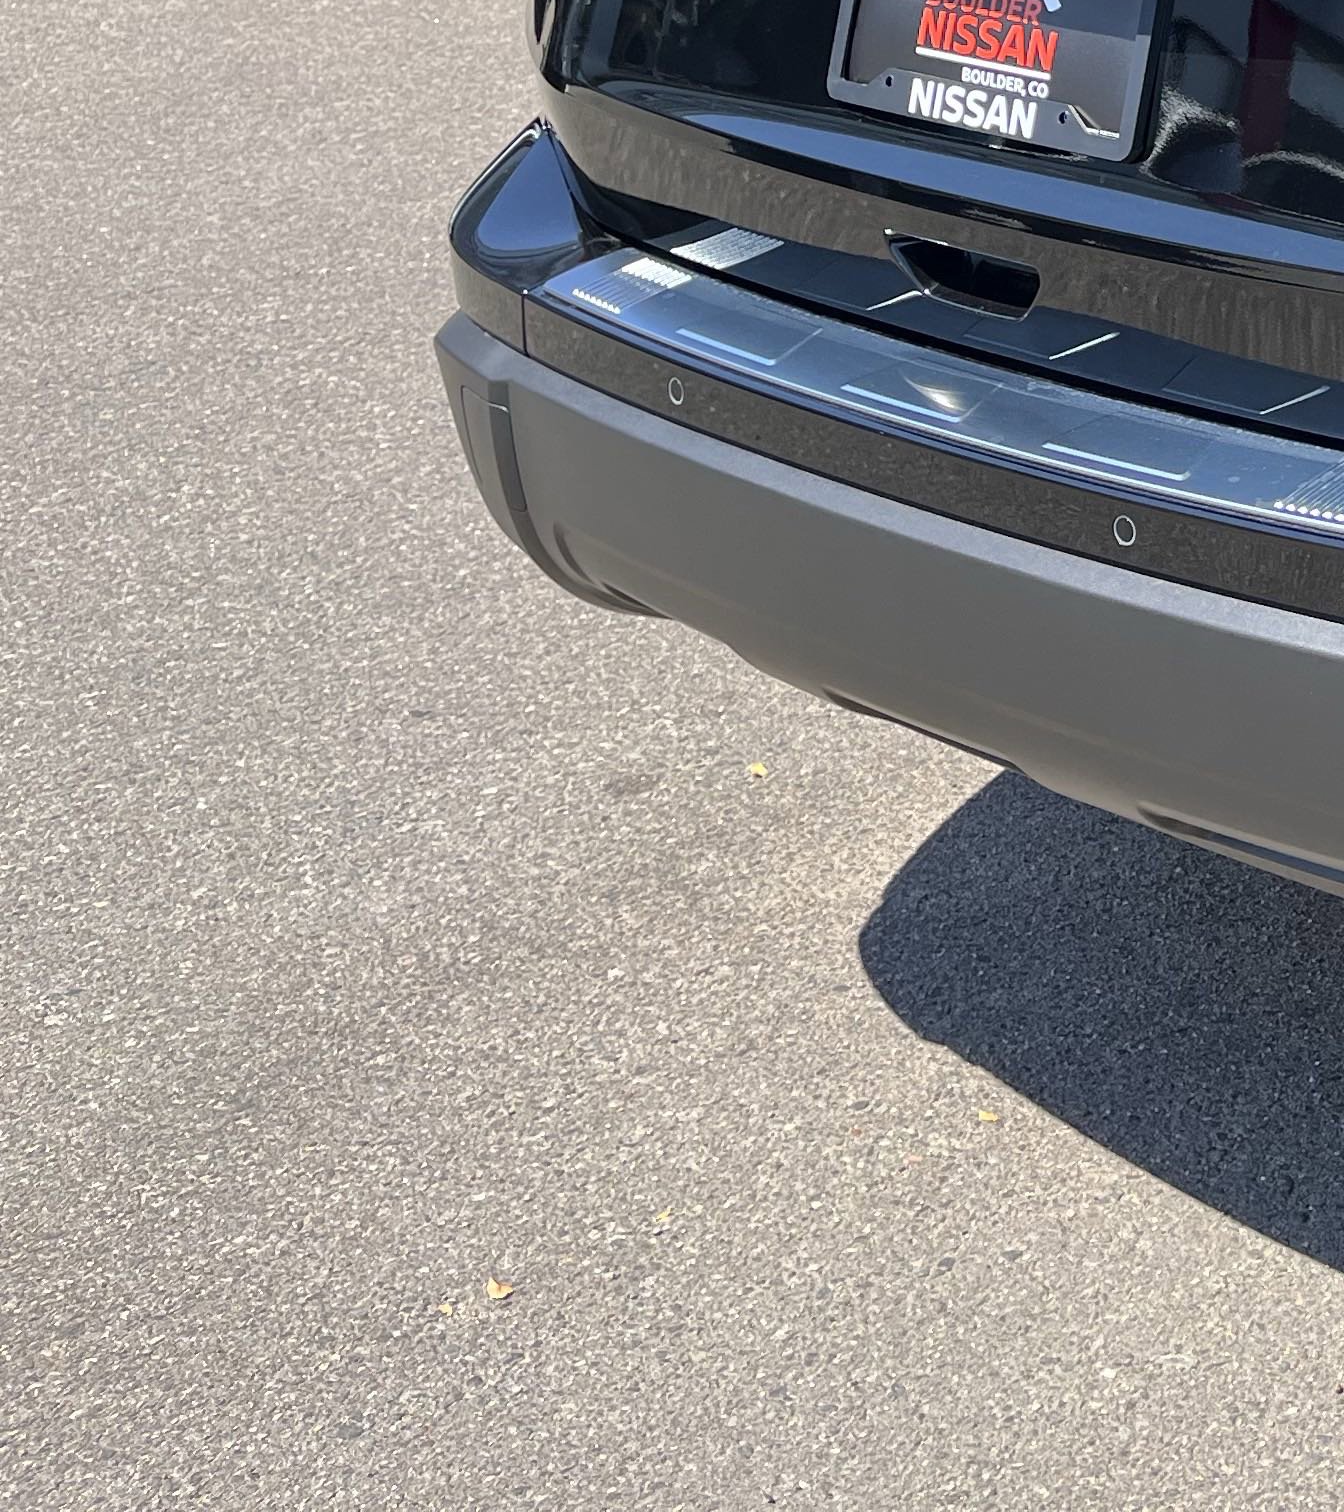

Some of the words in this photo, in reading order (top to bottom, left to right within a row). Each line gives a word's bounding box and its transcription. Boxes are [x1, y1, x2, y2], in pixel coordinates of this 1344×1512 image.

[916, 6, 1059, 72] NISSAN
[907, 77, 1038, 139] NISSAN
[961, 66, 1026, 97] BOULDER,
[1027, 80, 1049, 99] CO
